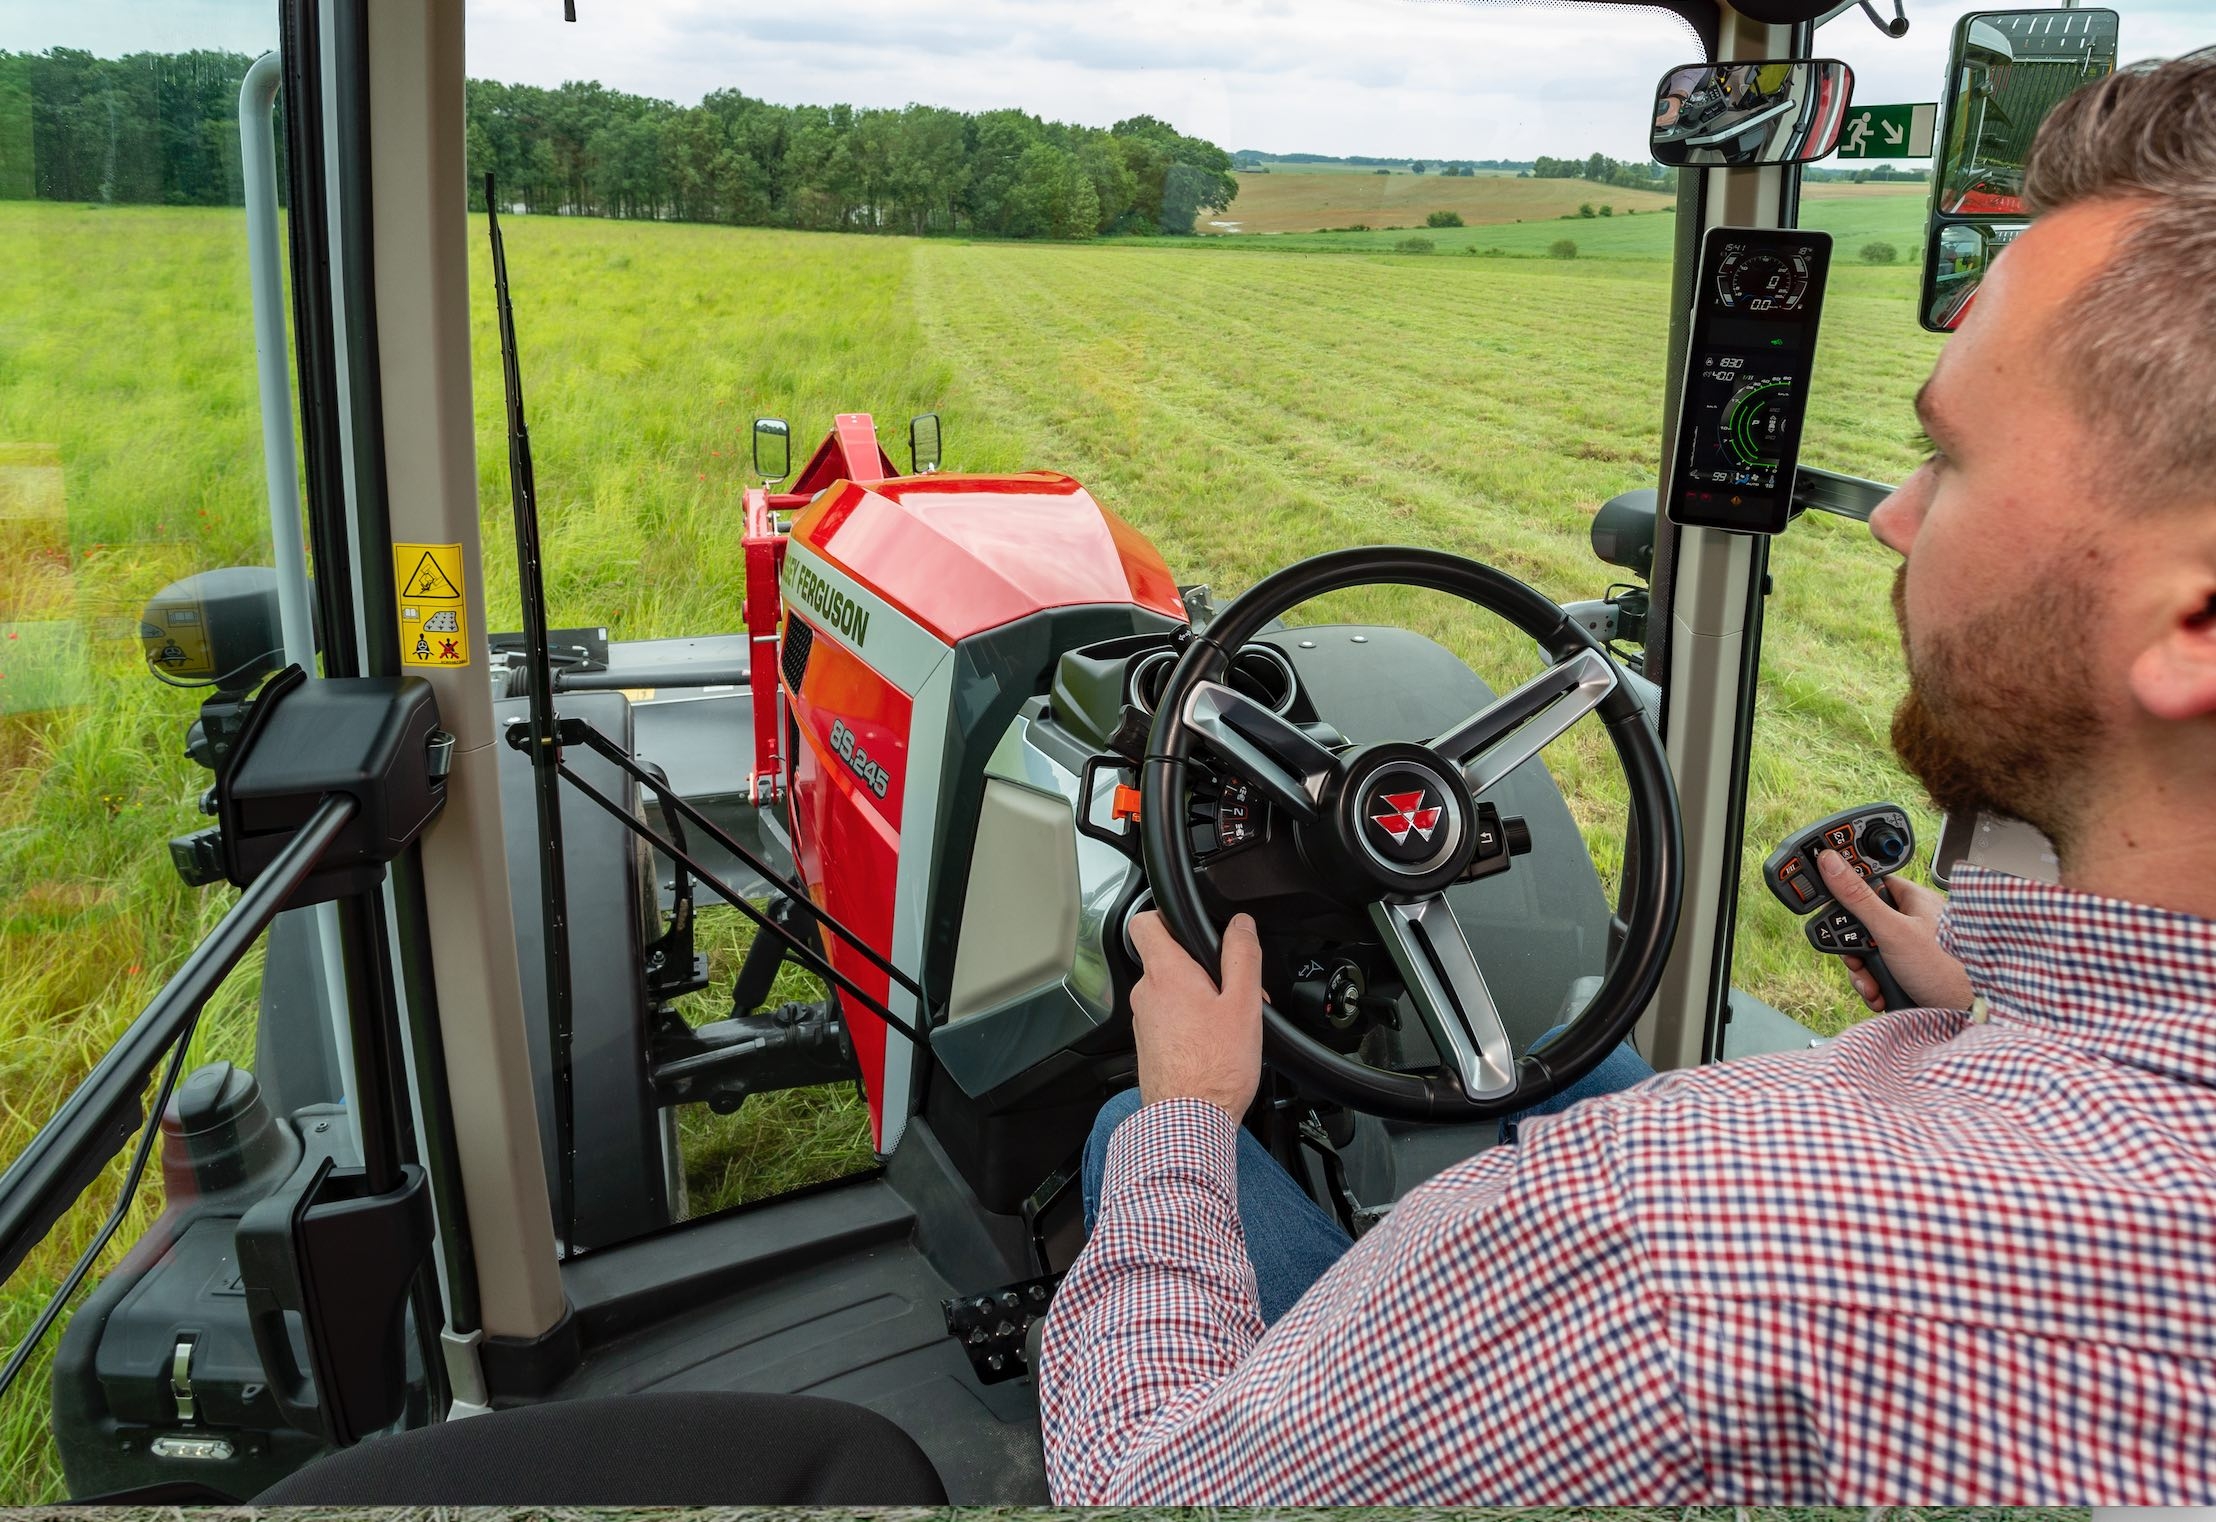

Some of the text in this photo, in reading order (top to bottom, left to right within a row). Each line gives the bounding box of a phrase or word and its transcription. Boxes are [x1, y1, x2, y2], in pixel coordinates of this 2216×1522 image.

[1725, 243, 1746, 252] 15:41
[1769, 276, 1780, 287] 0
[1750, 299, 1772, 310] 0.0
[1719, 358, 1744, 369] 1830
[1712, 371, 1735, 381] 40.0
[1712, 472, 1727, 481] 99
[796, 564, 870, 648] FERGUSON
[829, 719, 889, 799] 8S.245
[1836, 917, 1848, 925] F1
[1845, 933, 1857, 941] F2
